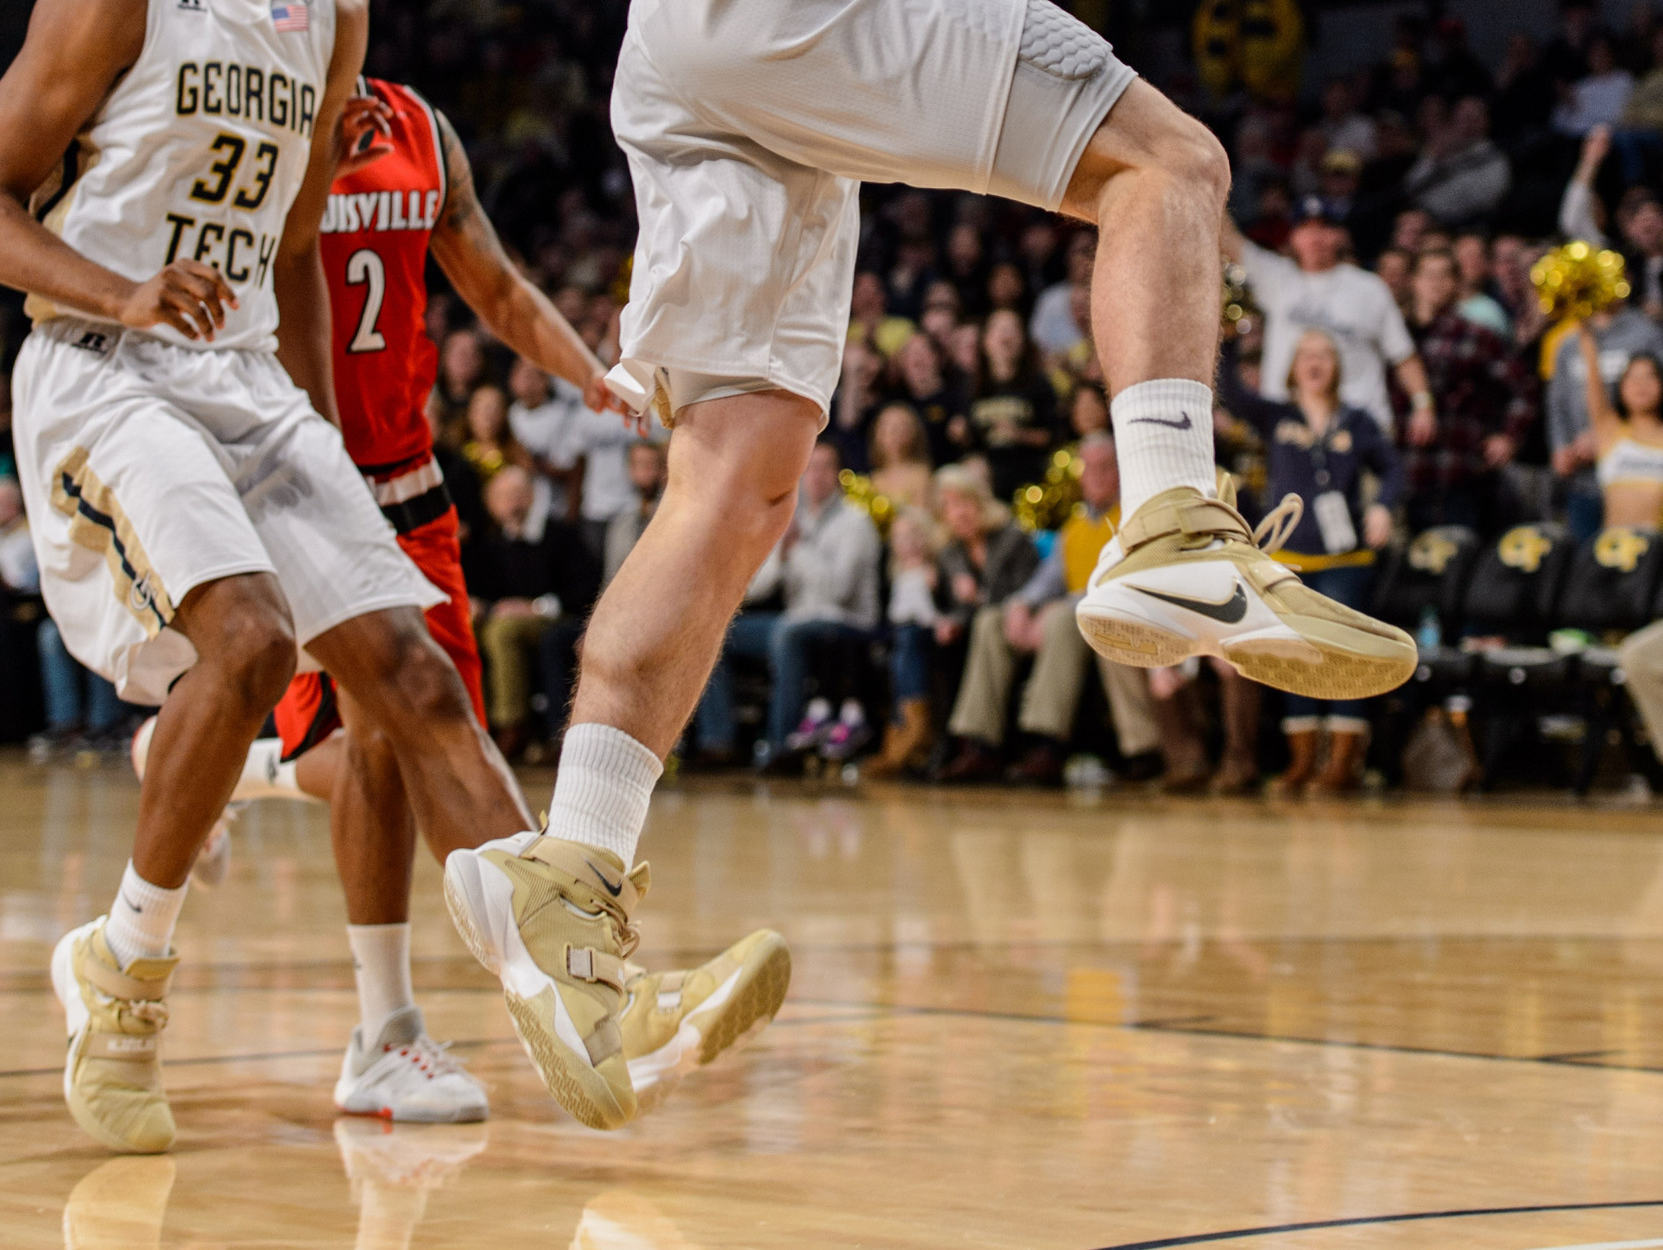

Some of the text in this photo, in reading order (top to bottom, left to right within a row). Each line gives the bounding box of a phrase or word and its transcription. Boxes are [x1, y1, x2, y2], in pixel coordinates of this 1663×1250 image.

[176, 62, 316, 140] GEORGIA
[190, 132, 280, 213] 33
[164, 213, 277, 290] TECH
[346, 249, 387, 354] 2
